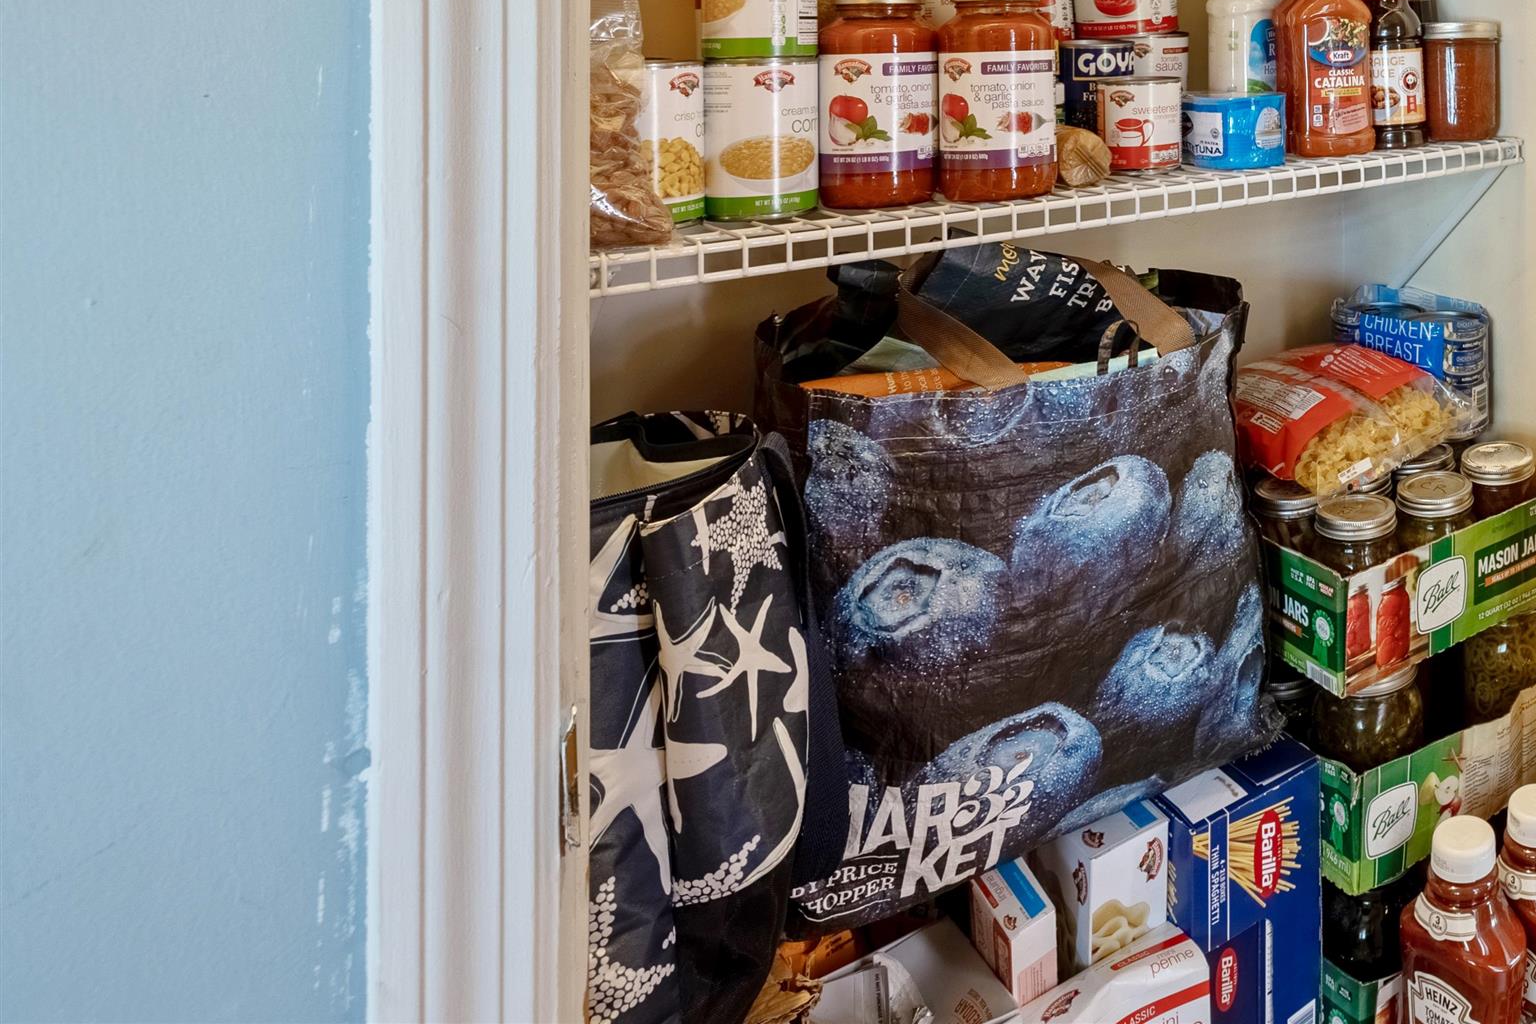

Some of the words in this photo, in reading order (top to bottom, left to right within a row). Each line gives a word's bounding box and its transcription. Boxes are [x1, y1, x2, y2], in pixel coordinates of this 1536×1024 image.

[1332, 51, 1349, 60] Kraft
[888, 64, 916, 74] FAMILY
[987, 64, 1014, 73] FAMILY
[1017, 62, 1049, 72] FAVORITES
[1155, 61, 1183, 72] sauce
[1328, 68, 1355, 77] CLASSIC
[970, 83, 1009, 93] tomato,
[1010, 81, 1036, 91] onion
[1314, 76, 1366, 89] CATALINA
[874, 94, 882, 103] &
[973, 92, 981, 102] &
[984, 92, 1012, 104] garlic
[674, 111, 695, 122] crisp
[1132, 104, 1179, 115] sweetened
[1195, 143, 1222, 155] TUNA
[1010, 249, 1048, 303] WAY
[1048, 257, 1080, 299] FIS
[1364, 314, 1431, 341] CHICKEN
[1365, 331, 1424, 364] BREAST
[1478, 542, 1519, 578] MASON
[1423, 570, 1461, 616] Ball
[1282, 593, 1309, 627] JARS
[1485, 603, 1503, 617] QUART
[1372, 796, 1411, 842] Ball
[1211, 844, 1220, 871] THIN
[1261, 821, 1277, 889] Barilla
[827, 861, 898, 888] PRICE
[1510, 875, 1516, 884] 3
[1211, 872, 1220, 926] SPAGHETTI
[1435, 916, 1441, 925] 3
[1151, 947, 1195, 978] penne
[1220, 955, 1233, 1005] Barilla
[1424, 986, 1459, 1016] HEINZ
